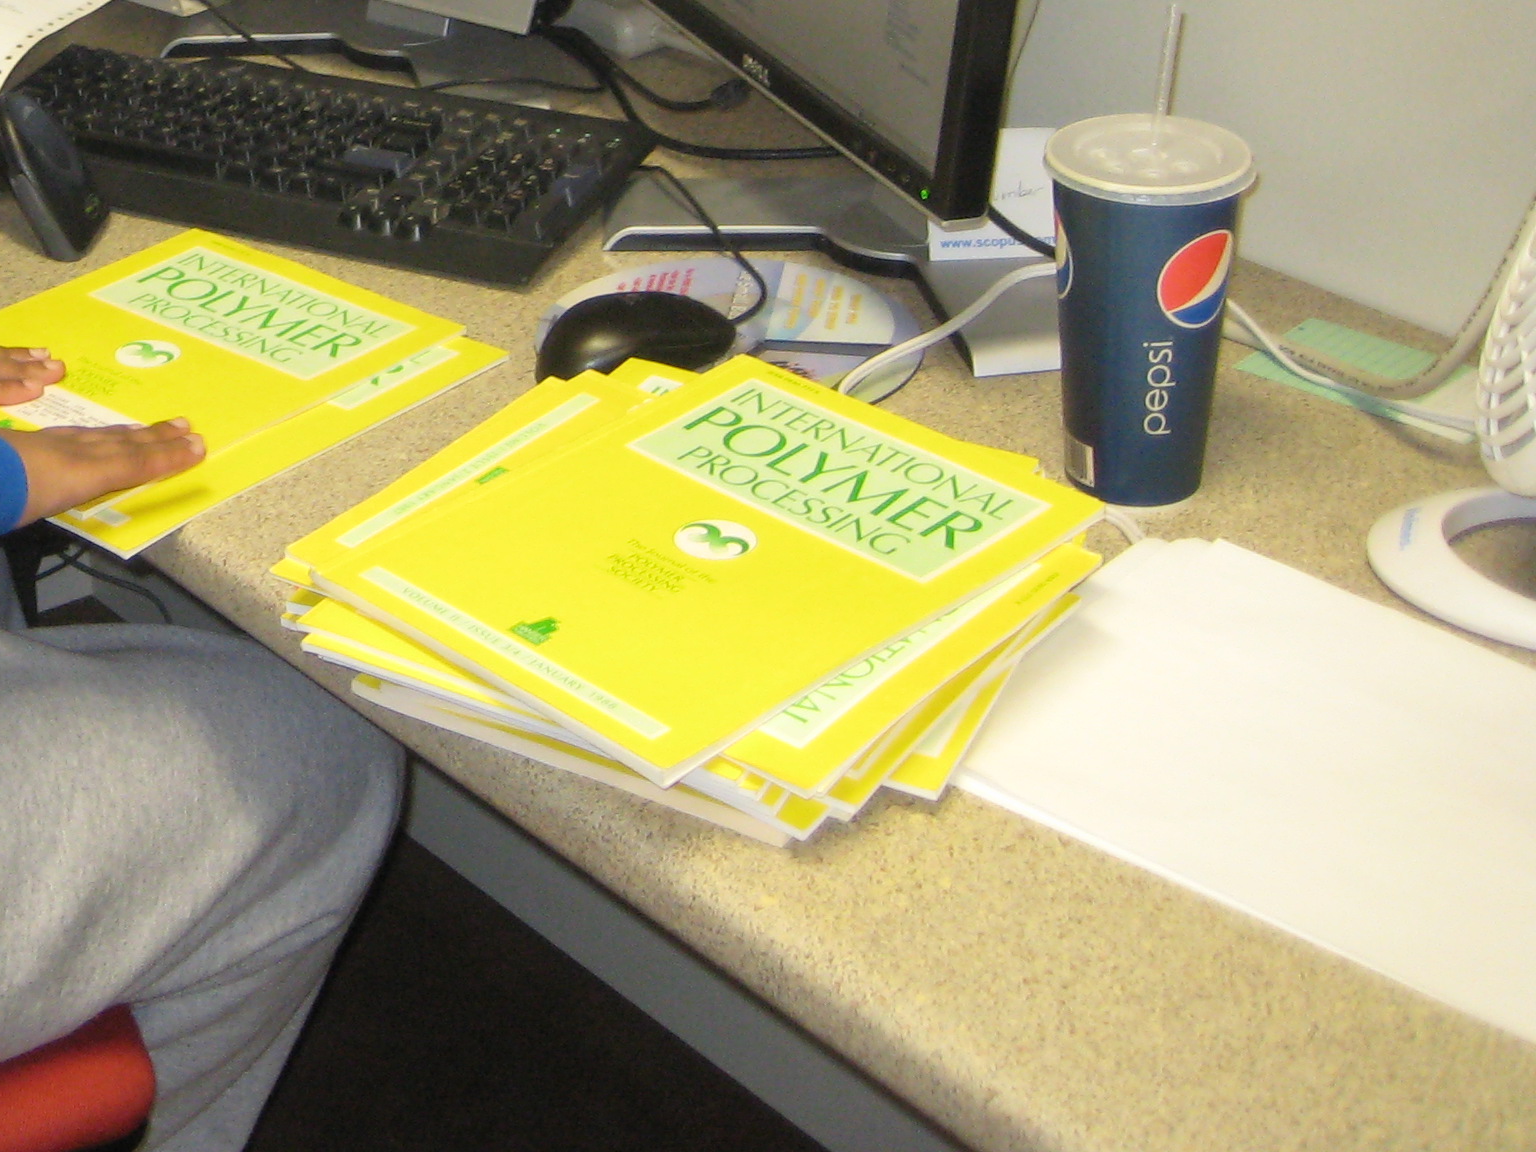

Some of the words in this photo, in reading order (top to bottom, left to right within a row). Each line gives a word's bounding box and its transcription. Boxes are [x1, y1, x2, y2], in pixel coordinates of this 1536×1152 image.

[129, 291, 302, 365] PROCESSING
[137, 264, 365, 360] POLYMER
[175, 250, 398, 341] INTERNATIONAL
[1142, 340, 1177, 436] pepsi
[676, 443, 915, 561] PROCESSING
[682, 404, 986, 552] POLYMER
[729, 386, 1029, 524] INTERNATIONAL
[401, 586, 450, 617] VOLUME
[528, 653, 584, 692] JANUARY
